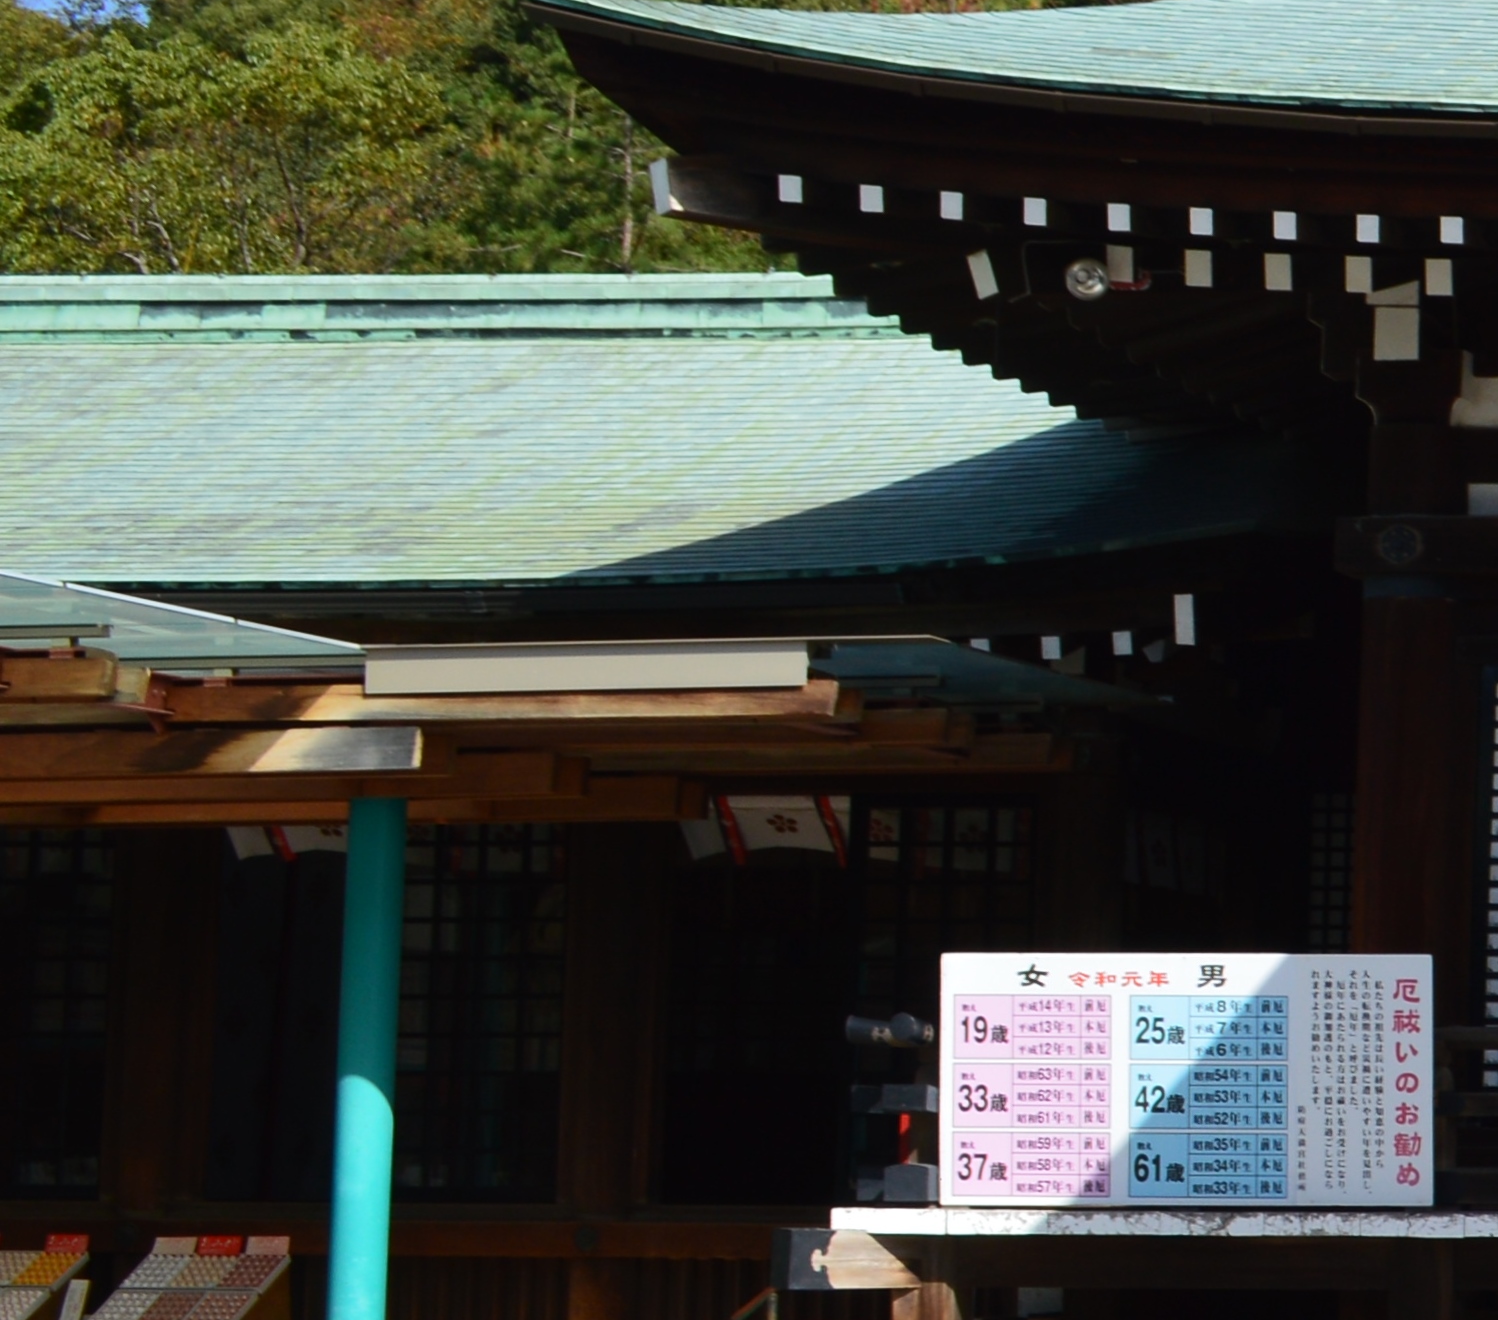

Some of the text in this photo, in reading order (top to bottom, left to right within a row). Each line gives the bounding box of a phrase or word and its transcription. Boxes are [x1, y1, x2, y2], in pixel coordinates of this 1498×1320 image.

[1017, 964, 1227, 988] 女 令和元年 男
[961, 1016, 1009, 1043] 19歳
[1135, 1017, 1185, 1045] 25歳
[1392, 979, 1422, 1186] 厄祓いのお勧め
[958, 1084, 1008, 1112] 33歳
[1134, 1085, 1185, 1114] 42歳
[957, 1153, 1008, 1181] 37歳
[1134, 1153, 1184, 1182] 61歳
